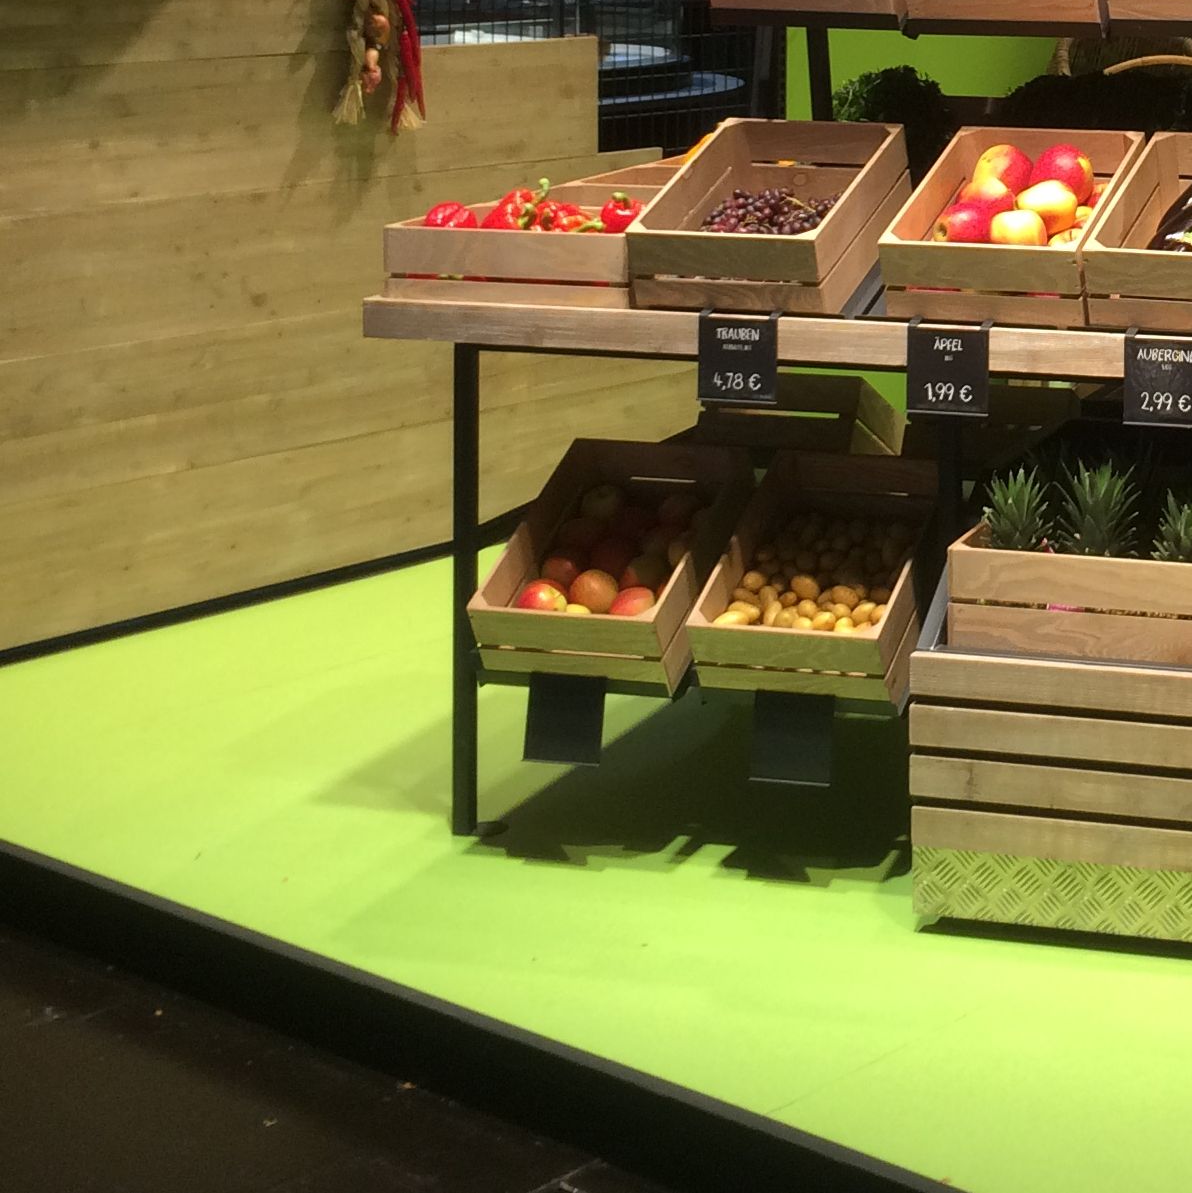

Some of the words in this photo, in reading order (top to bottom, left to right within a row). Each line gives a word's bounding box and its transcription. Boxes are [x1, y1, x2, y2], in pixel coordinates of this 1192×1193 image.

[716, 327, 760, 342] TRAUBEN
[934, 336, 963, 352] ÄPFEL
[714, 371, 745, 391] 4,78
[748, 372, 762, 391] €
[924, 382, 955, 403] 1,99
[959, 384, 974, 402] €
[1140, 392, 1174, 412] 2,99
[1178, 395, 1192, 412] €
